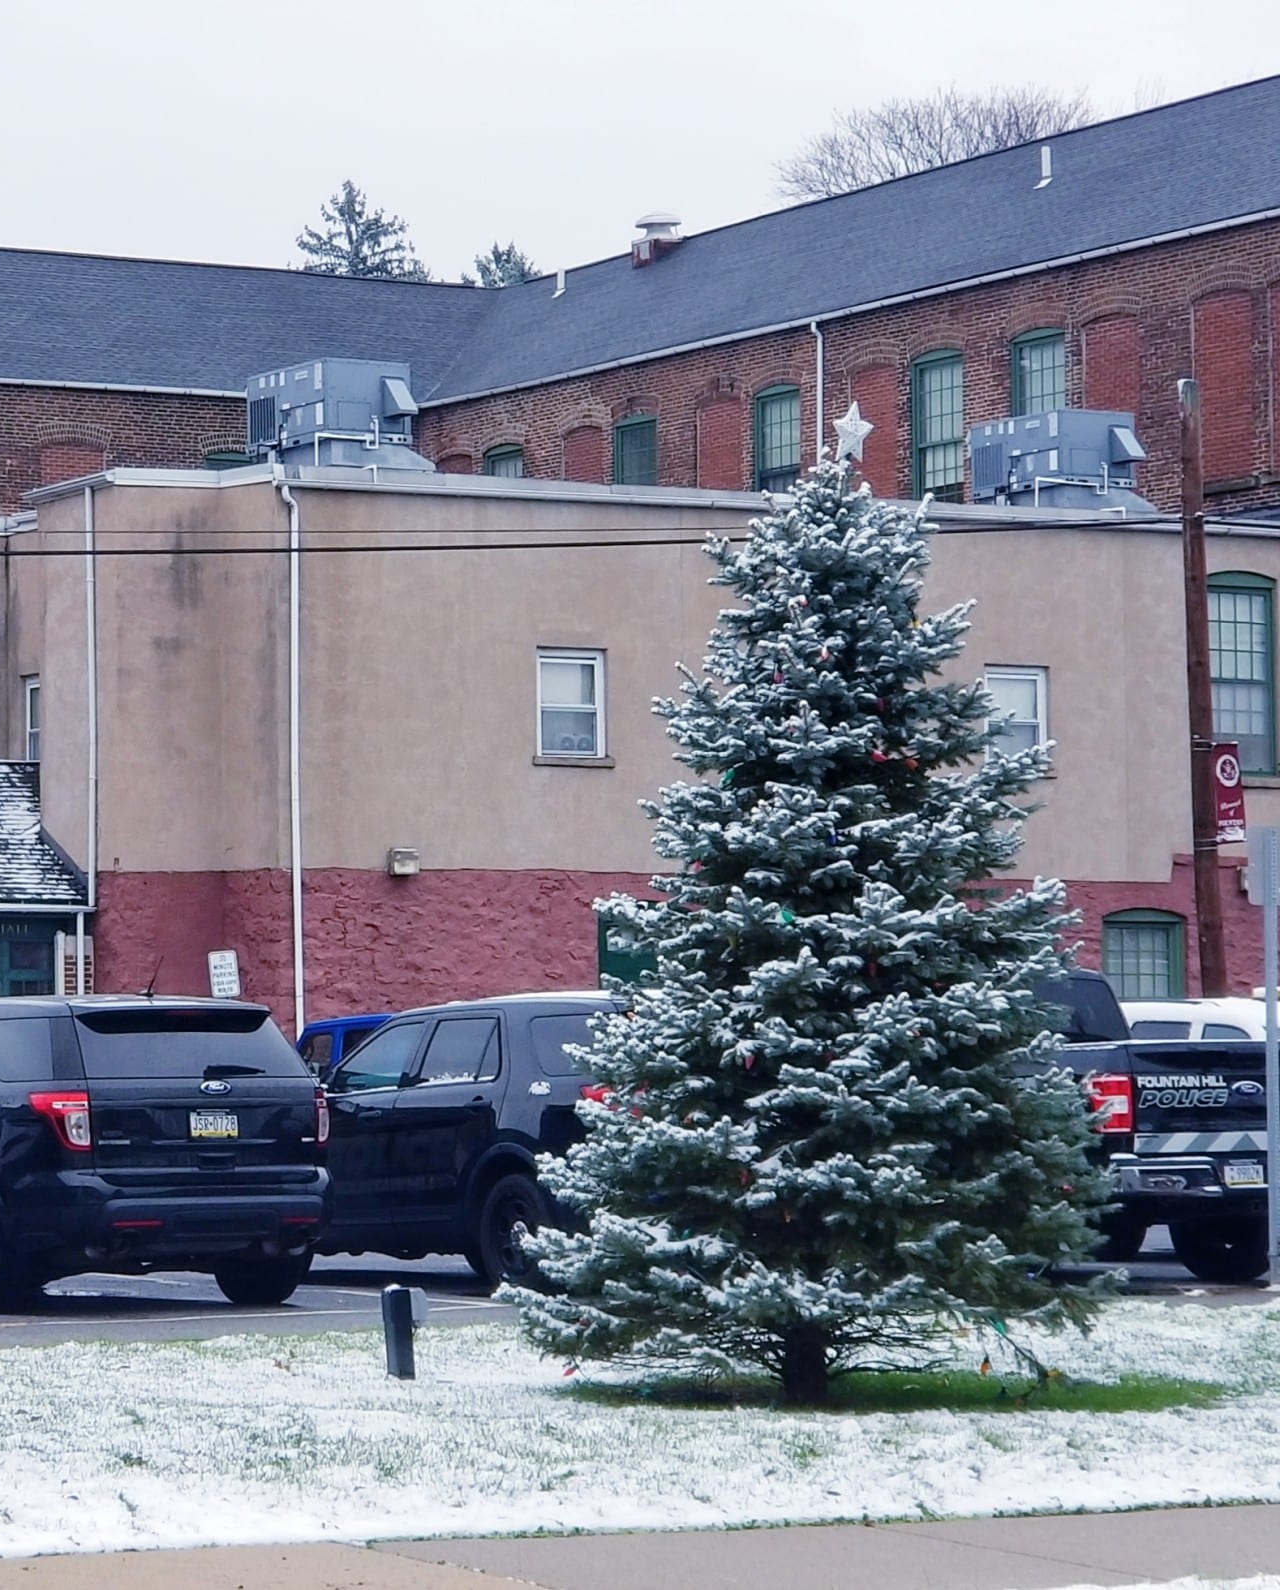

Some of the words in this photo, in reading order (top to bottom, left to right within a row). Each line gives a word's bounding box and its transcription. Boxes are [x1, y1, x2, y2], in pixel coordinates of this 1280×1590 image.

[1137, 1075, 1200, 1089] FOUNTAIN
[1201, 1074, 1228, 1088] HILL
[1138, 1089, 1229, 1109] POLICE
